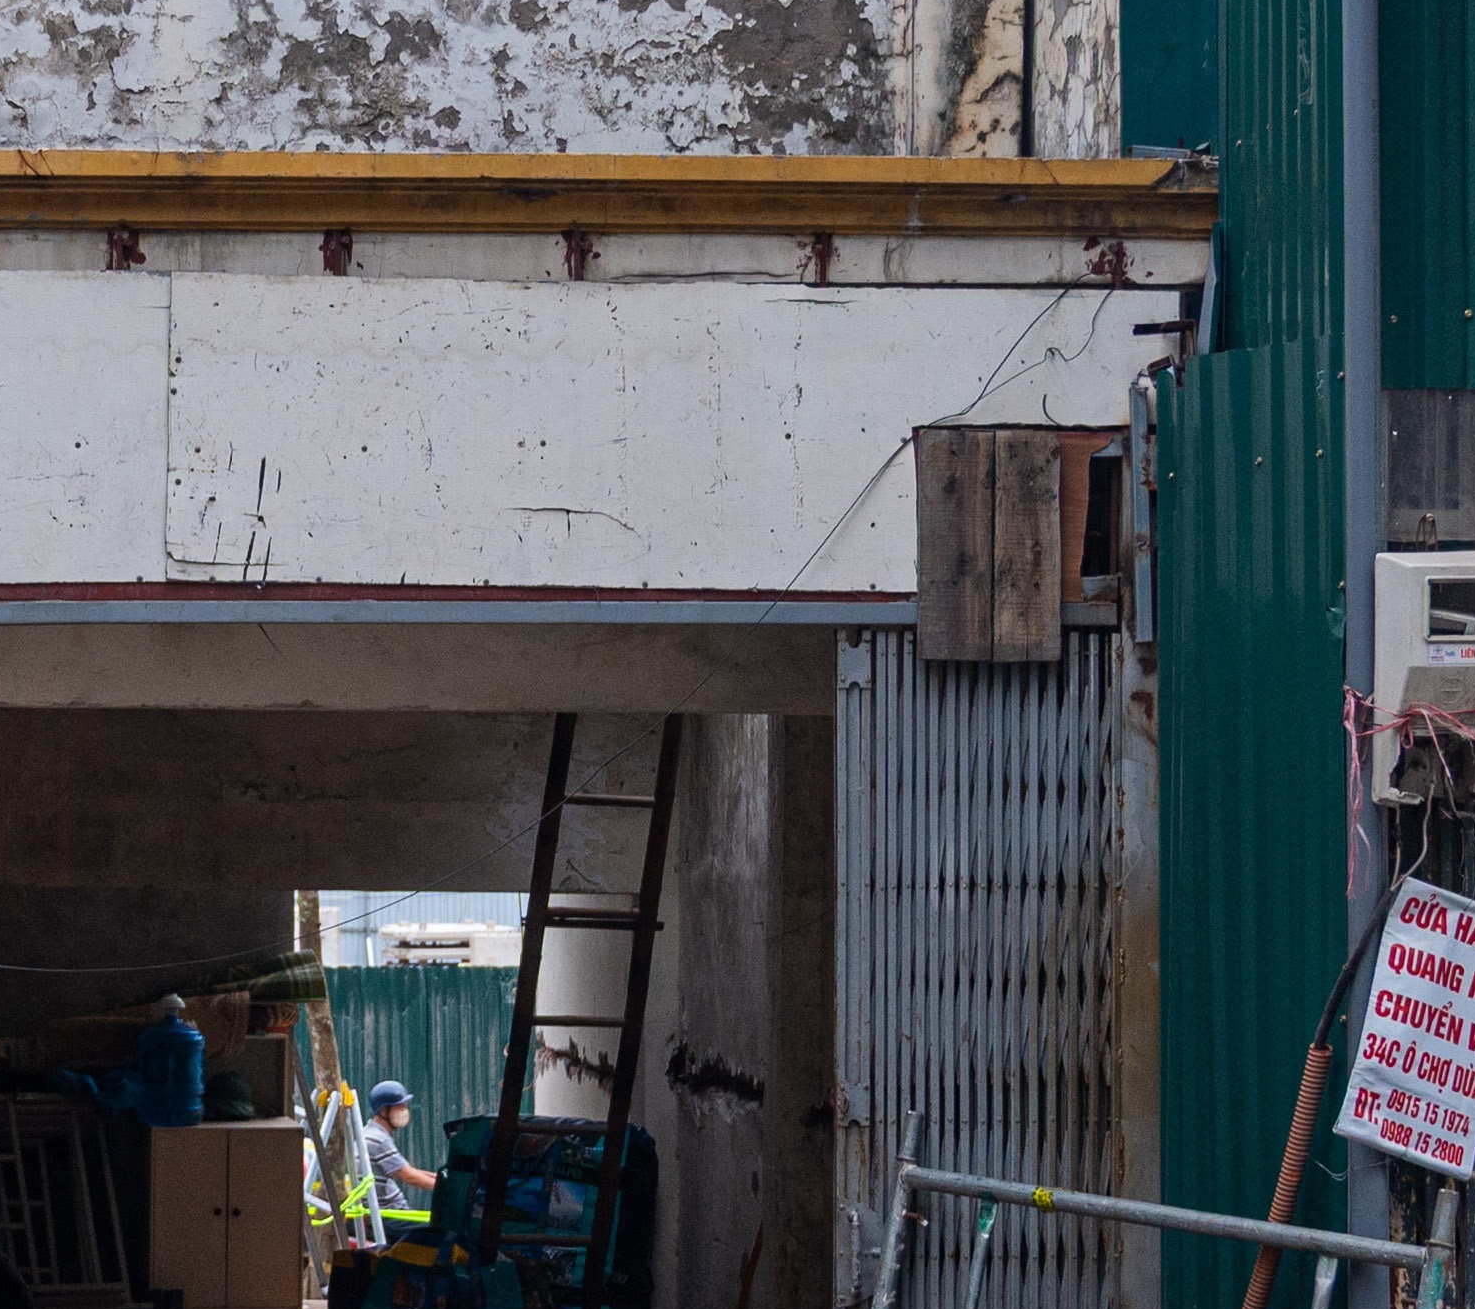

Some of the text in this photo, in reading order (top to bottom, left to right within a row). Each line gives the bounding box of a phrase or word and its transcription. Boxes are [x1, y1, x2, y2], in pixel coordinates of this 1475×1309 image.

[1400, 893, 1448, 936] CỬA
[1388, 943, 1465, 994] QUANG
[1375, 989, 1464, 1045] CHUYỂN
[1362, 1033, 1401, 1068] 34C
[1401, 1040, 1417, 1074] Ô
[1417, 1052, 1453, 1093] CHỢ
[1354, 1087, 1470, 1137] ĐT: 0915 15 1974
[1380, 1118, 1464, 1166] 0988 15 2800
